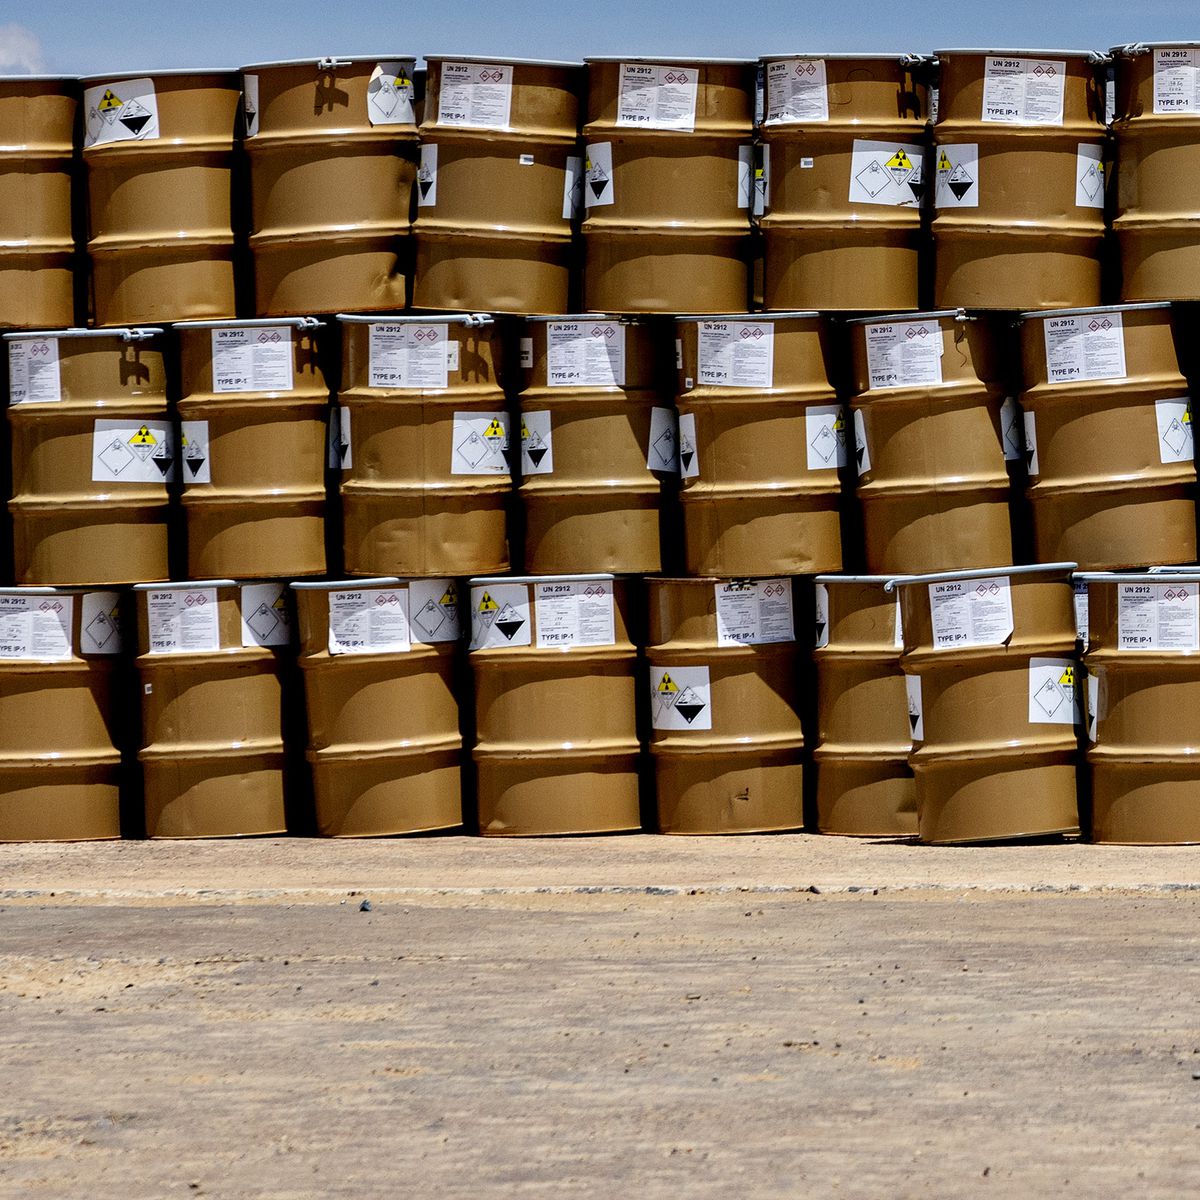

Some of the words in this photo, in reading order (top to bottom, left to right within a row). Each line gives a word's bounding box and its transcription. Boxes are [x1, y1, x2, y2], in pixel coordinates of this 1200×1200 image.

[621, 114, 637, 122] TYPE
[946, 584, 962, 592] 2912
[937, 634, 954, 642] TYPE
